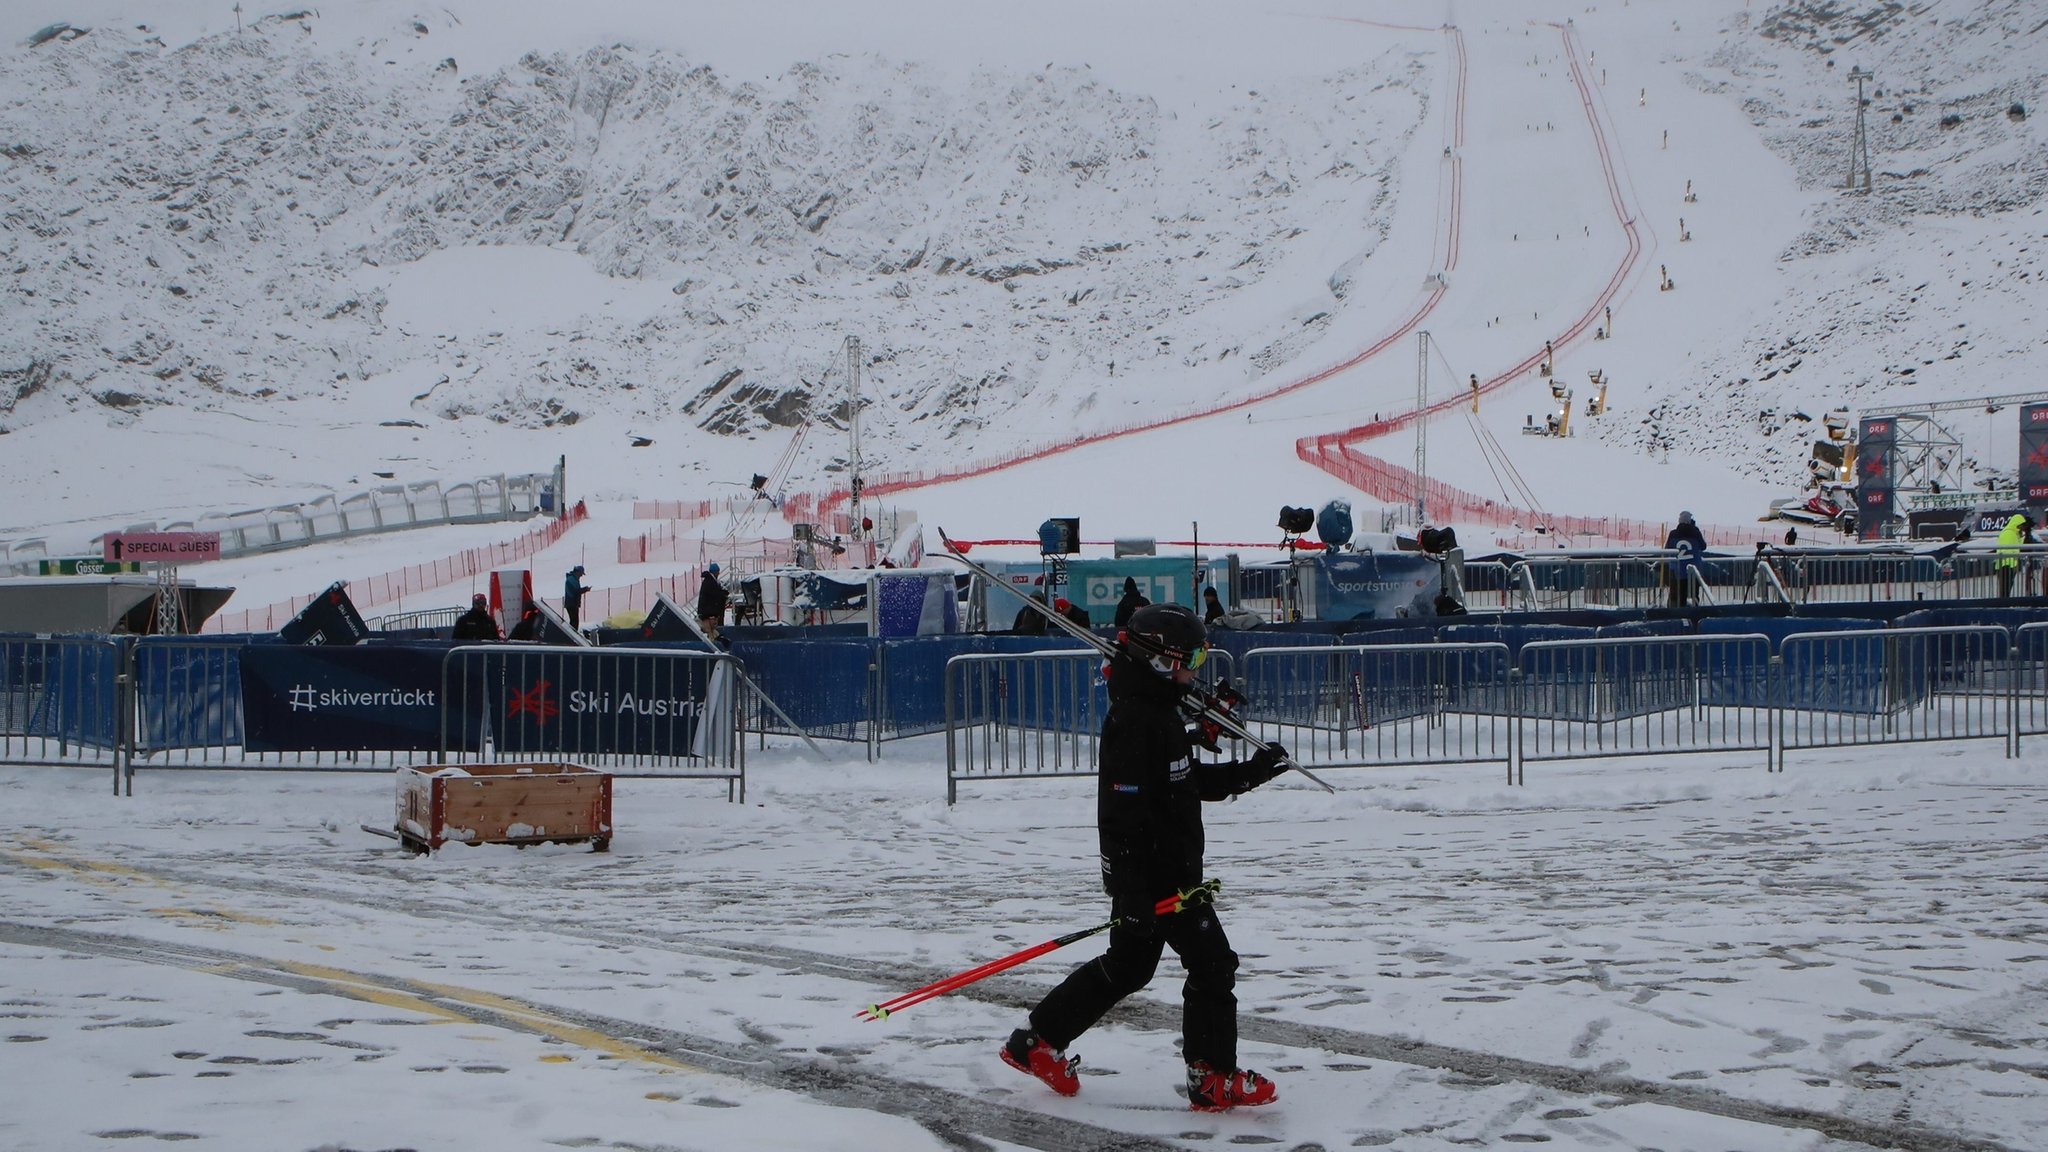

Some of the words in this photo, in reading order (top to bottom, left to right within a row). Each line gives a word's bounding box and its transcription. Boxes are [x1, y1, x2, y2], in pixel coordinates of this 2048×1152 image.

[1869, 425, 1885, 433] ORF
[1867, 495, 1883, 503] ORF
[128, 542, 177, 553] SPECIAL
[179, 541, 217, 552] GUEST
[1676, 540, 1694, 560] 2
[75, 560, 104, 575] Gösser
[289, 684, 435, 712] #skiverrückt
[569, 690, 609, 713] Ski
[618, 692, 706, 717] Austria
